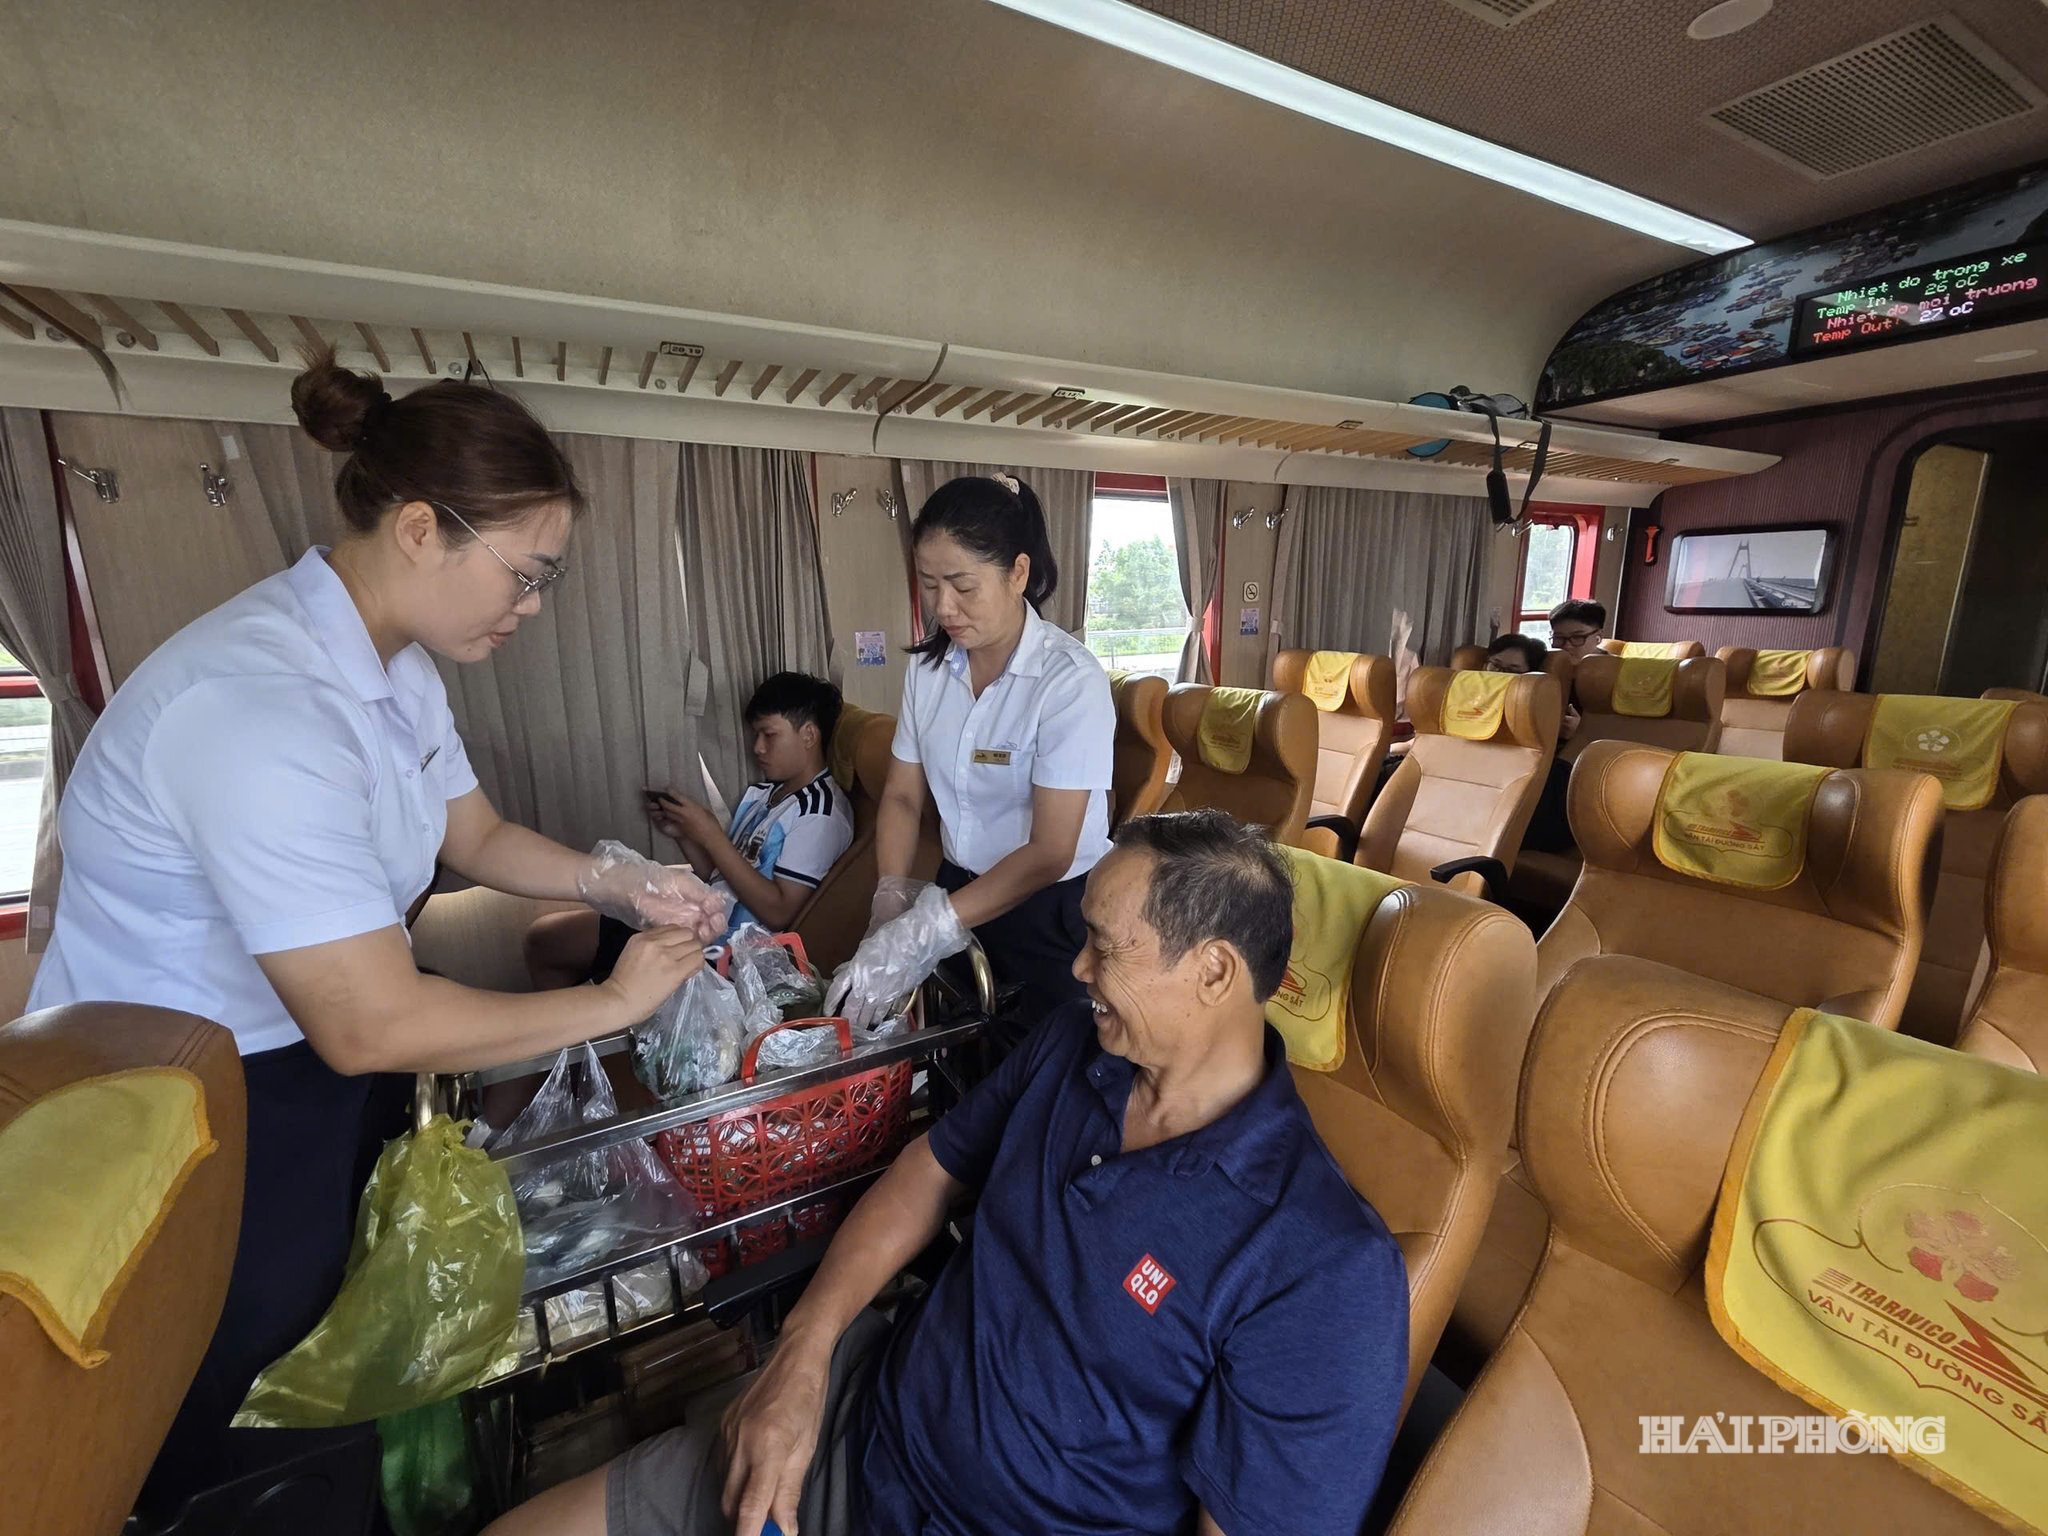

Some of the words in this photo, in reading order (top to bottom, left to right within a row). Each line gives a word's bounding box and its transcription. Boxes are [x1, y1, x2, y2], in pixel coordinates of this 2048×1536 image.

[1837, 282, 1889, 303] Nhiet
[1899, 276, 1920, 289] do
[1932, 261, 1990, 280] trong
[2001, 252, 2027, 266] xe
[1818, 304, 1856, 319] Temp
[1925, 281, 1949, 295] 26
[1827, 310, 1877, 329] Nhiet
[1887, 304, 1908, 317] do
[1918, 293, 1950, 311] moi
[1965, 277, 2038, 300] truong
[1813, 329, 1852, 343] Temp
[1919, 307, 1943, 322] 27
[1130, 1273, 1159, 1306] QLO
[1142, 1259, 1169, 1291] UNI
[1849, 1281, 1957, 1345] TRARAVICO
[1808, 1289, 1855, 1323] VẬN
[1862, 1318, 1900, 1348] TẢI
[1904, 1342, 2005, 1405] ĐƯỜNG
